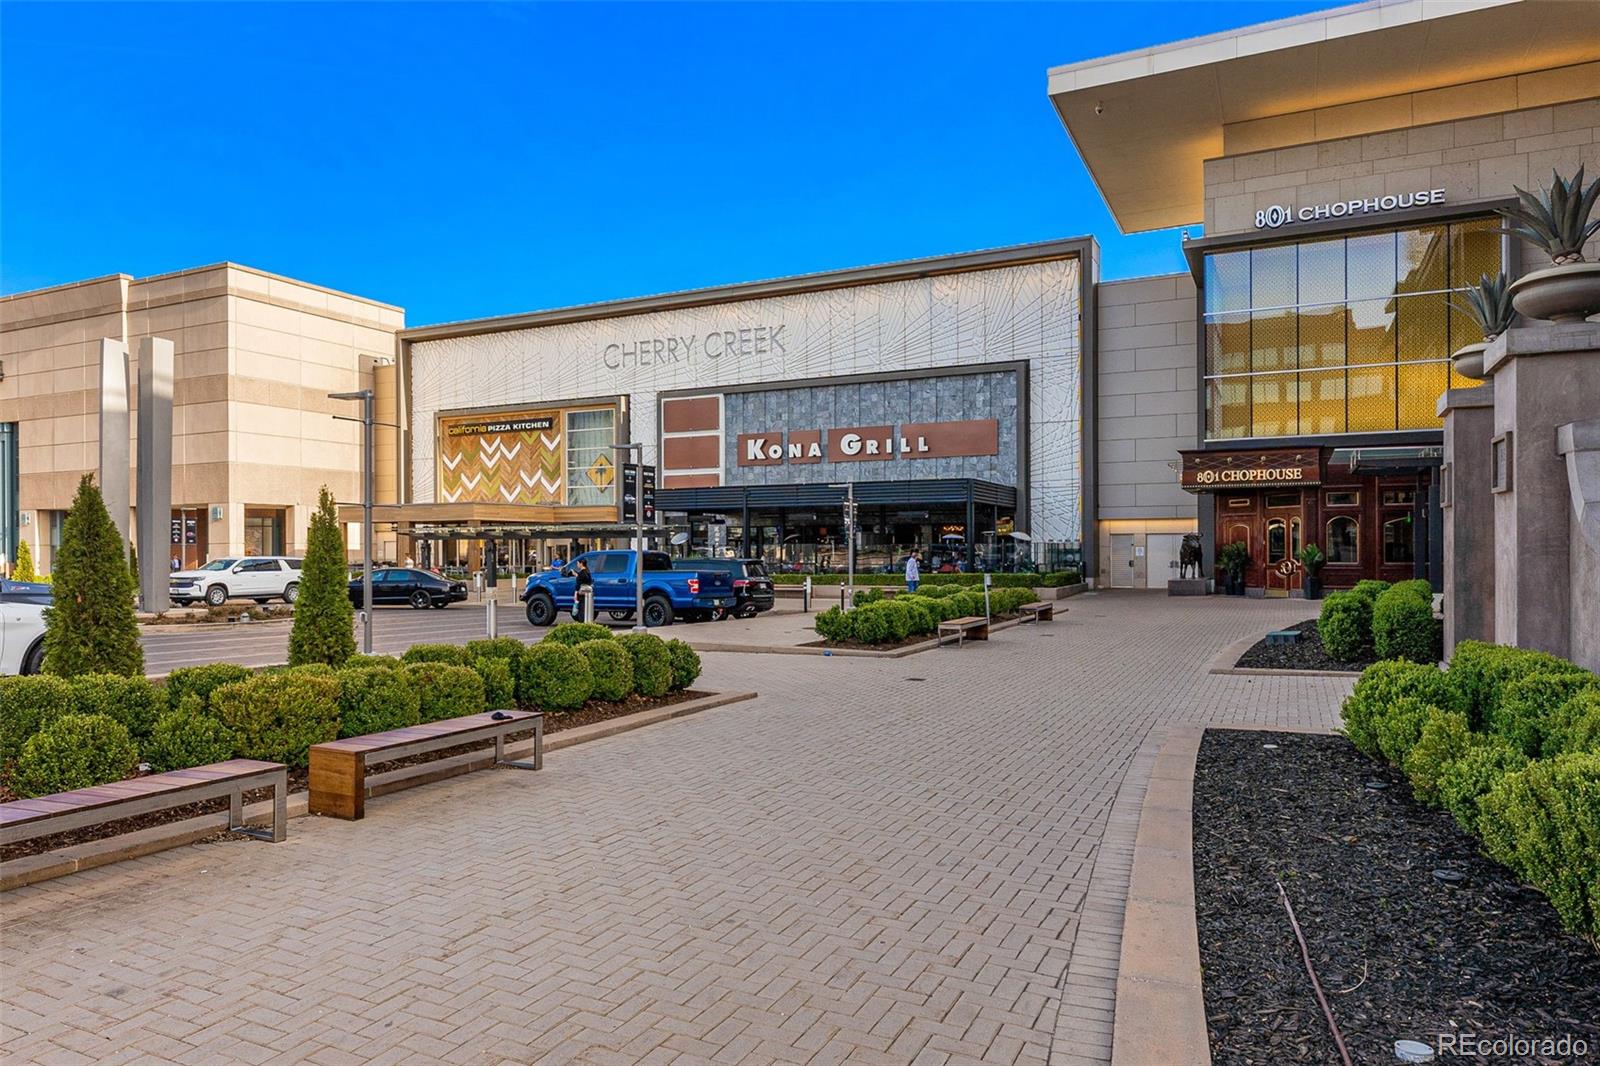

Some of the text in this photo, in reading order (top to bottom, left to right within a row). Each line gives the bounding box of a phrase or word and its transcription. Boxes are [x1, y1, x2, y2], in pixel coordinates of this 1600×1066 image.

[1254, 188, 1446, 228] 801 CHOPHOUSE
[603, 324, 786, 370] CHERRY CREEK
[487, 424, 511, 432] PIZZA
[512, 421, 549, 430] KITCHEN
[747, 433, 929, 460] KONA GRILL
[1196, 468, 1303, 484] 801 CHOPHOUSE
